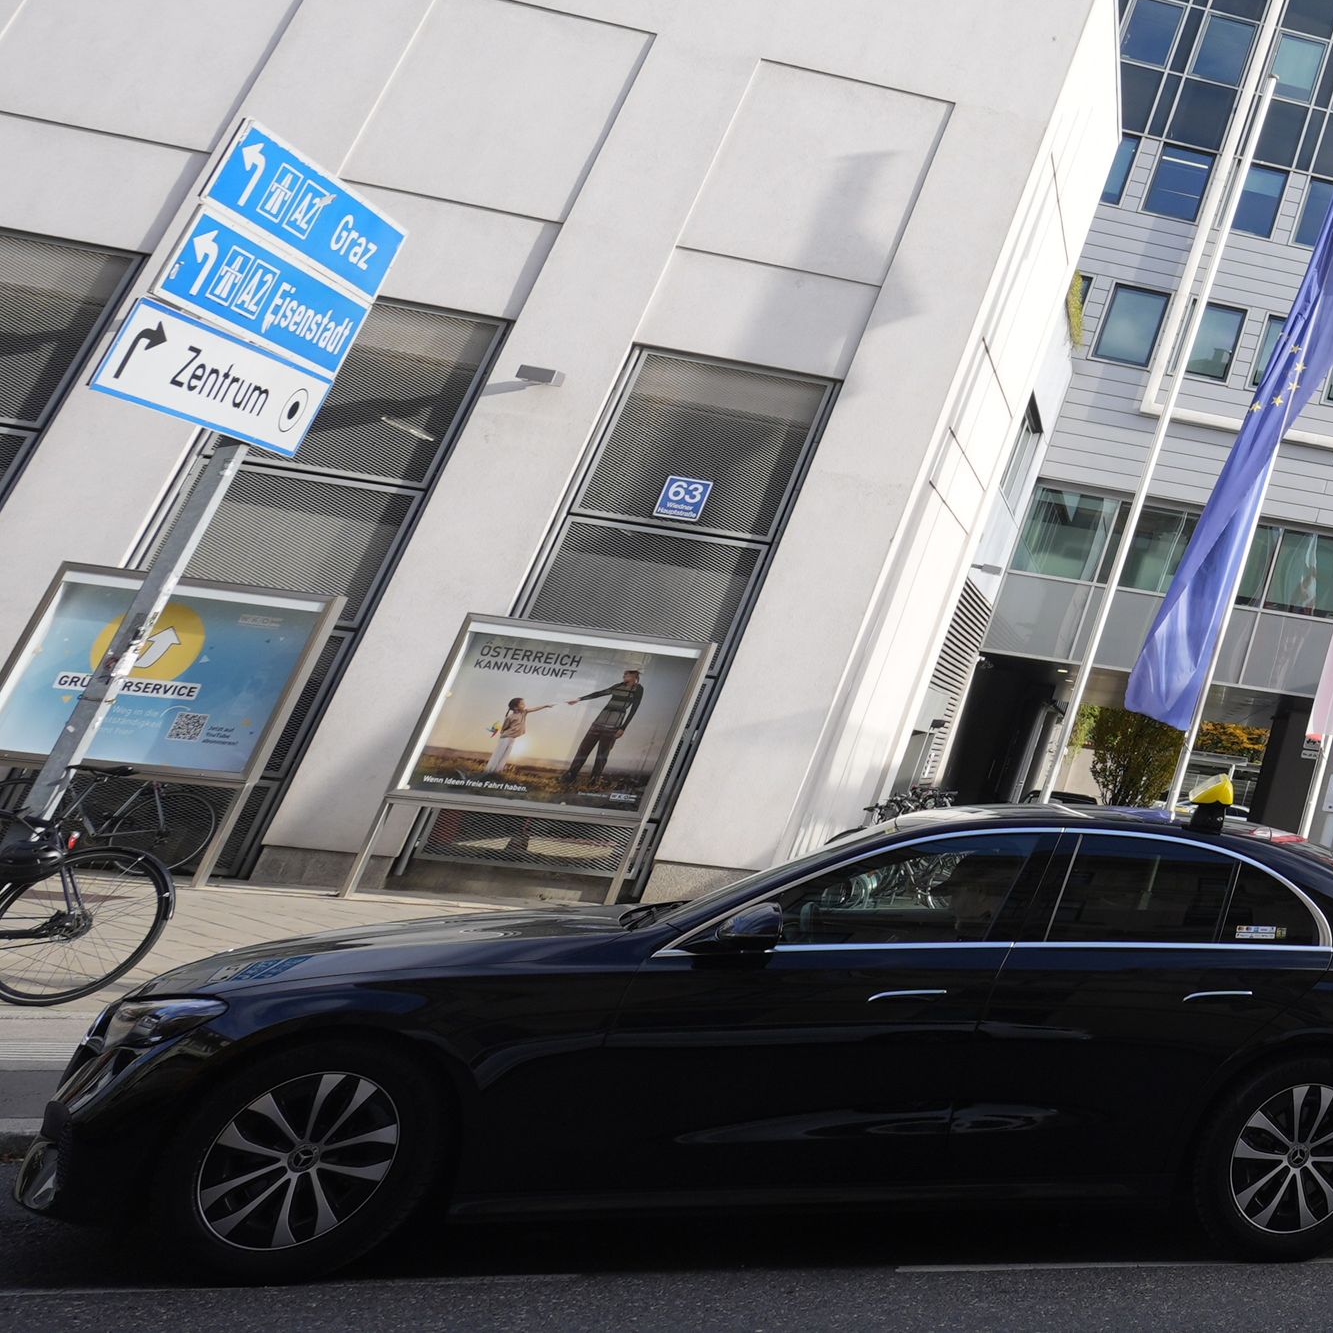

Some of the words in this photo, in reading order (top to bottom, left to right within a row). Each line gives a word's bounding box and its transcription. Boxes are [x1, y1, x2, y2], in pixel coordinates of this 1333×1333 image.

[289, 196, 321, 231] A2
[329, 214, 378, 272] Graz
[237, 268, 274, 314] A2
[270, 282, 354, 356] Eisenstadt
[169, 345, 270, 418] Zentrum
[668, 481, 704, 504] 63
[480, 641, 583, 668] ÖSTERREICH
[473, 658, 513, 673] KANN
[514, 663, 578, 680] ZUKUNFT
[423, 775, 444, 784] Wenn
[444, 777, 465, 787] Ideen
[465, 779, 482, 788] freie
[483, 780, 504, 790] Fahrt
[504, 784, 528, 793] haben.
